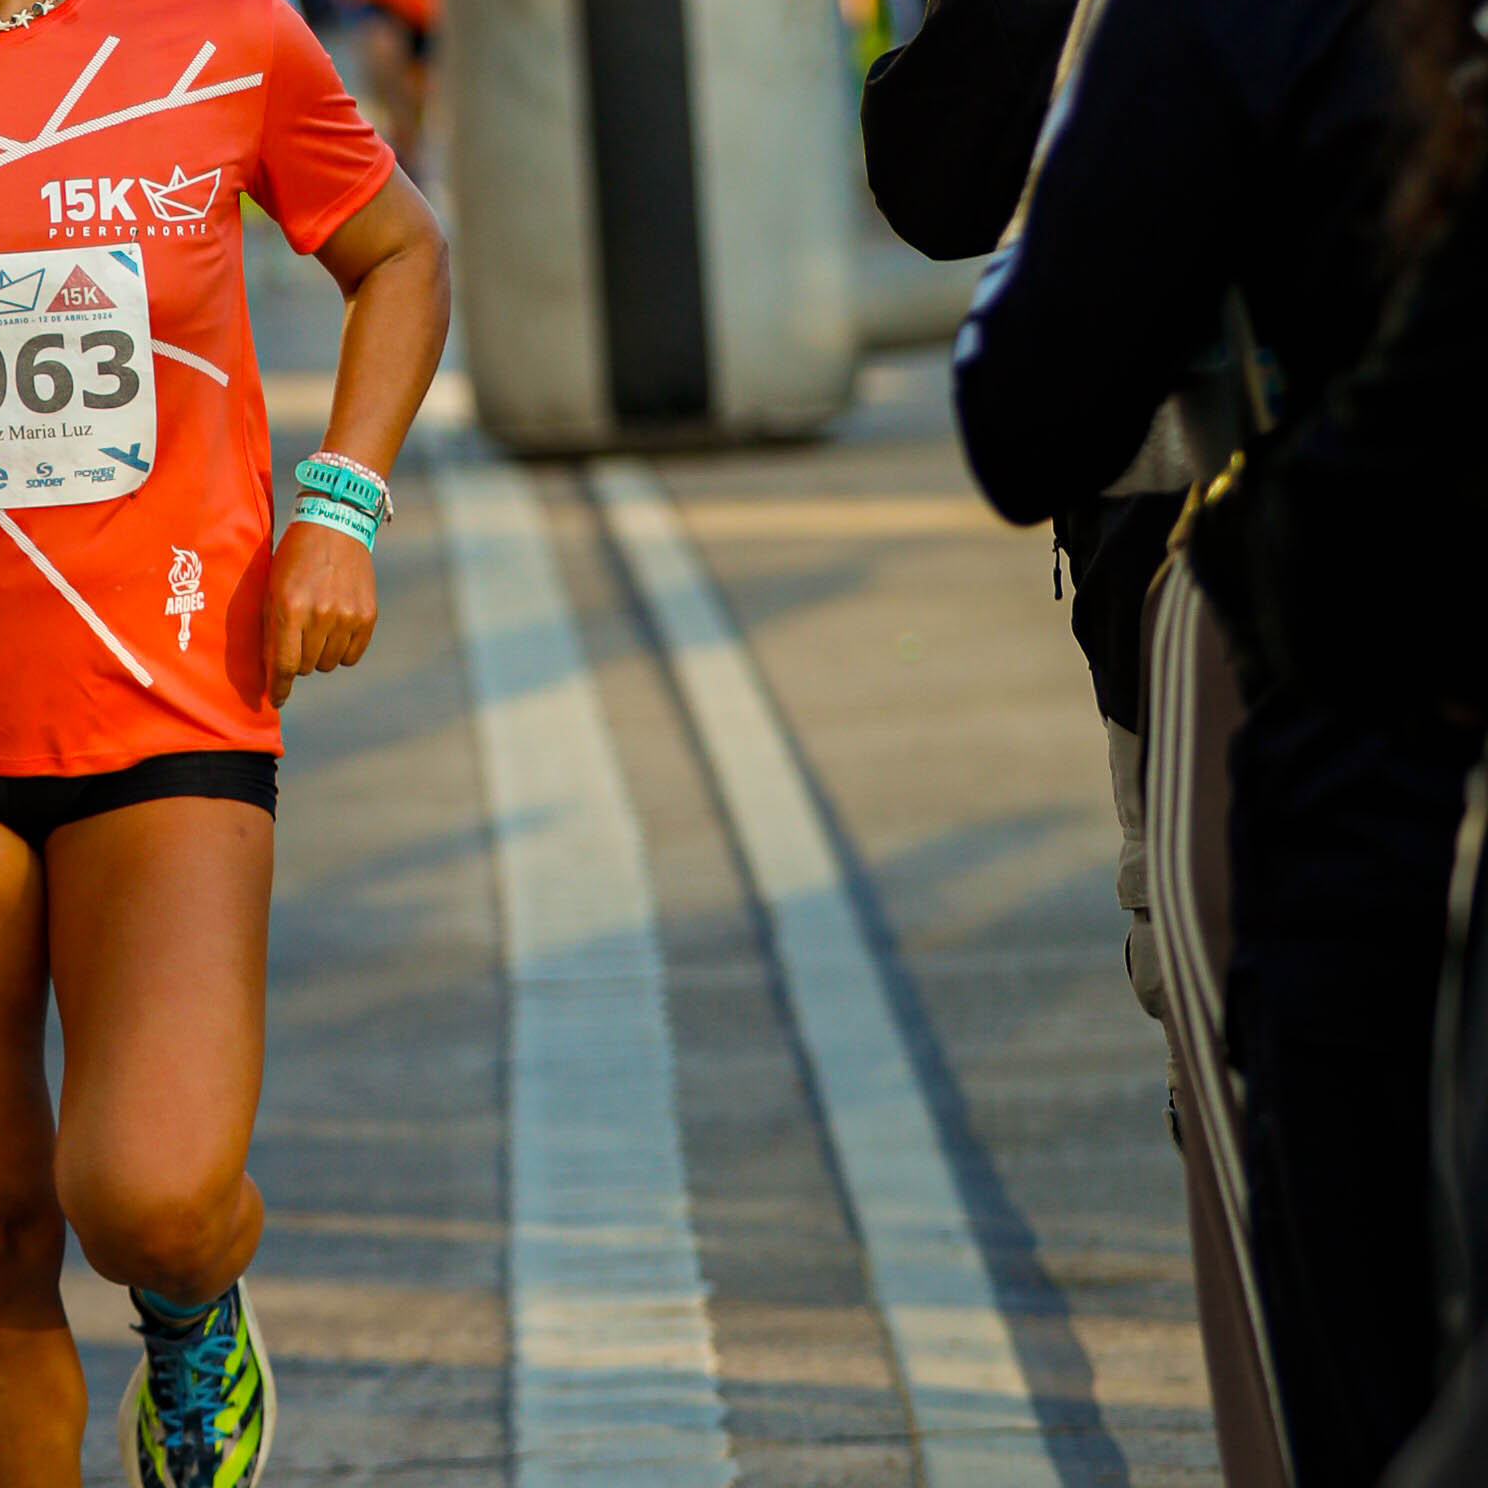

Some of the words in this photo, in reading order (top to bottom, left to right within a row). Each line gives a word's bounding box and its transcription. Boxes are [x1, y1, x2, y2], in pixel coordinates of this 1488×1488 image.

[40, 177, 137, 224] 15K
[49, 226, 139, 239] PUERTO
[147, 224, 206, 237] NORTE
[60, 286, 100, 306] 15K
[38, 315, 48, 323] 12
[51, 314, 62, 323] DE
[64, 313, 89, 322] ABRIL
[8, 423, 56, 441] Maria
[61, 422, 94, 437] Luz
[164, 591, 205, 616] ARDEC
